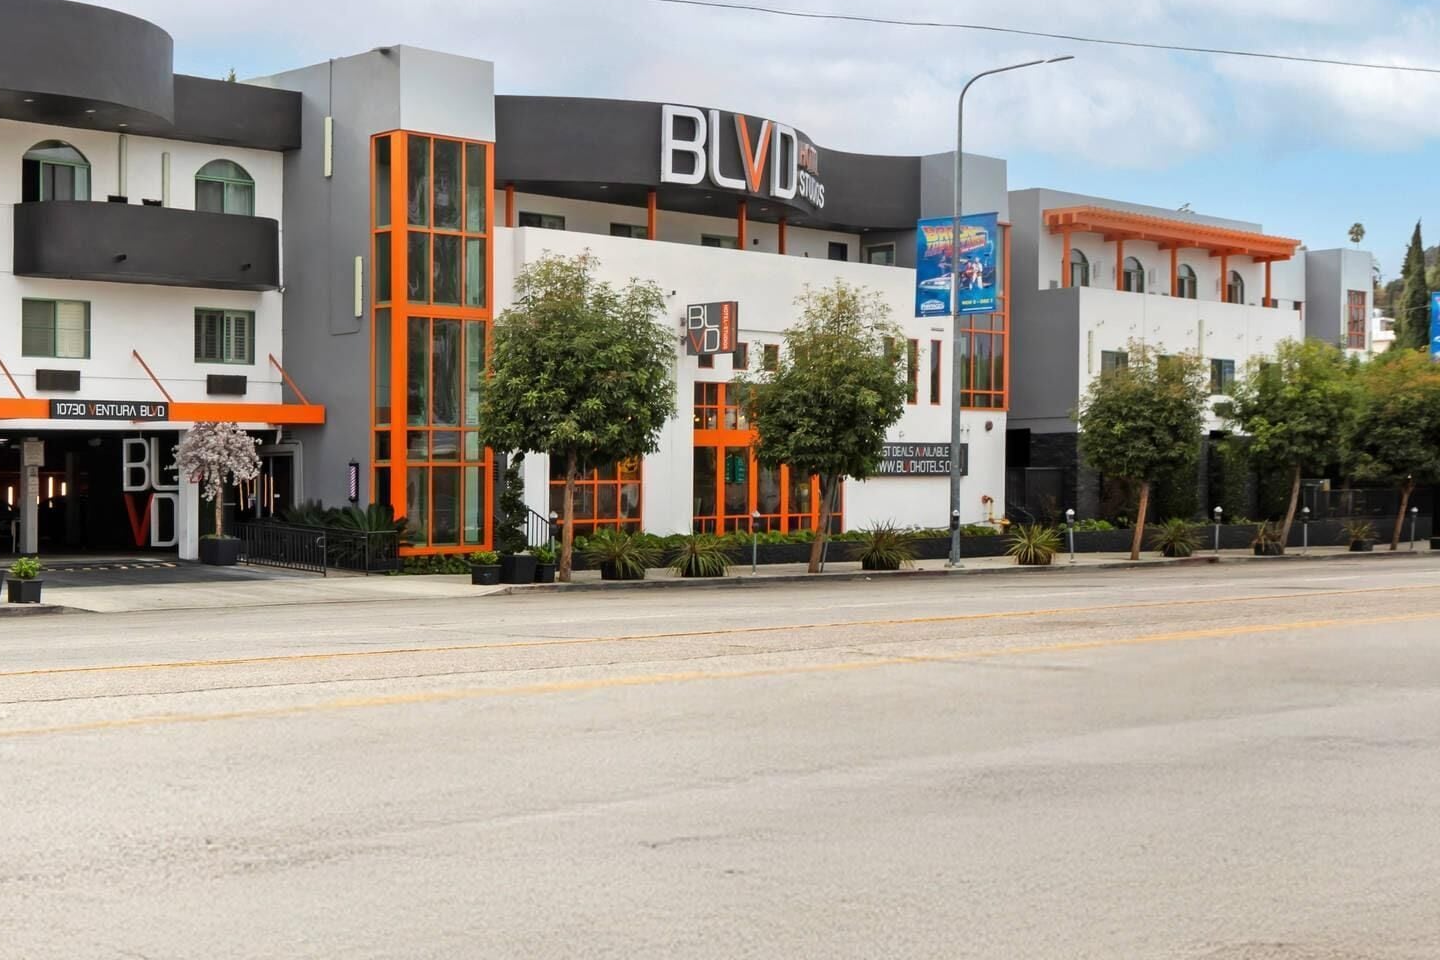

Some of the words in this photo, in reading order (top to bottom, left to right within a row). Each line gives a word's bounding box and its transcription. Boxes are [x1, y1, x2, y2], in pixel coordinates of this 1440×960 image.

[661, 104, 797, 200] BLVD
[56, 403, 86, 416] 10730
[88, 403, 137, 417] VENTURA
[140, 405, 165, 417] BLVD
[892, 446, 914, 457] DEALS
[914, 446, 949, 457] AVAILABLE
